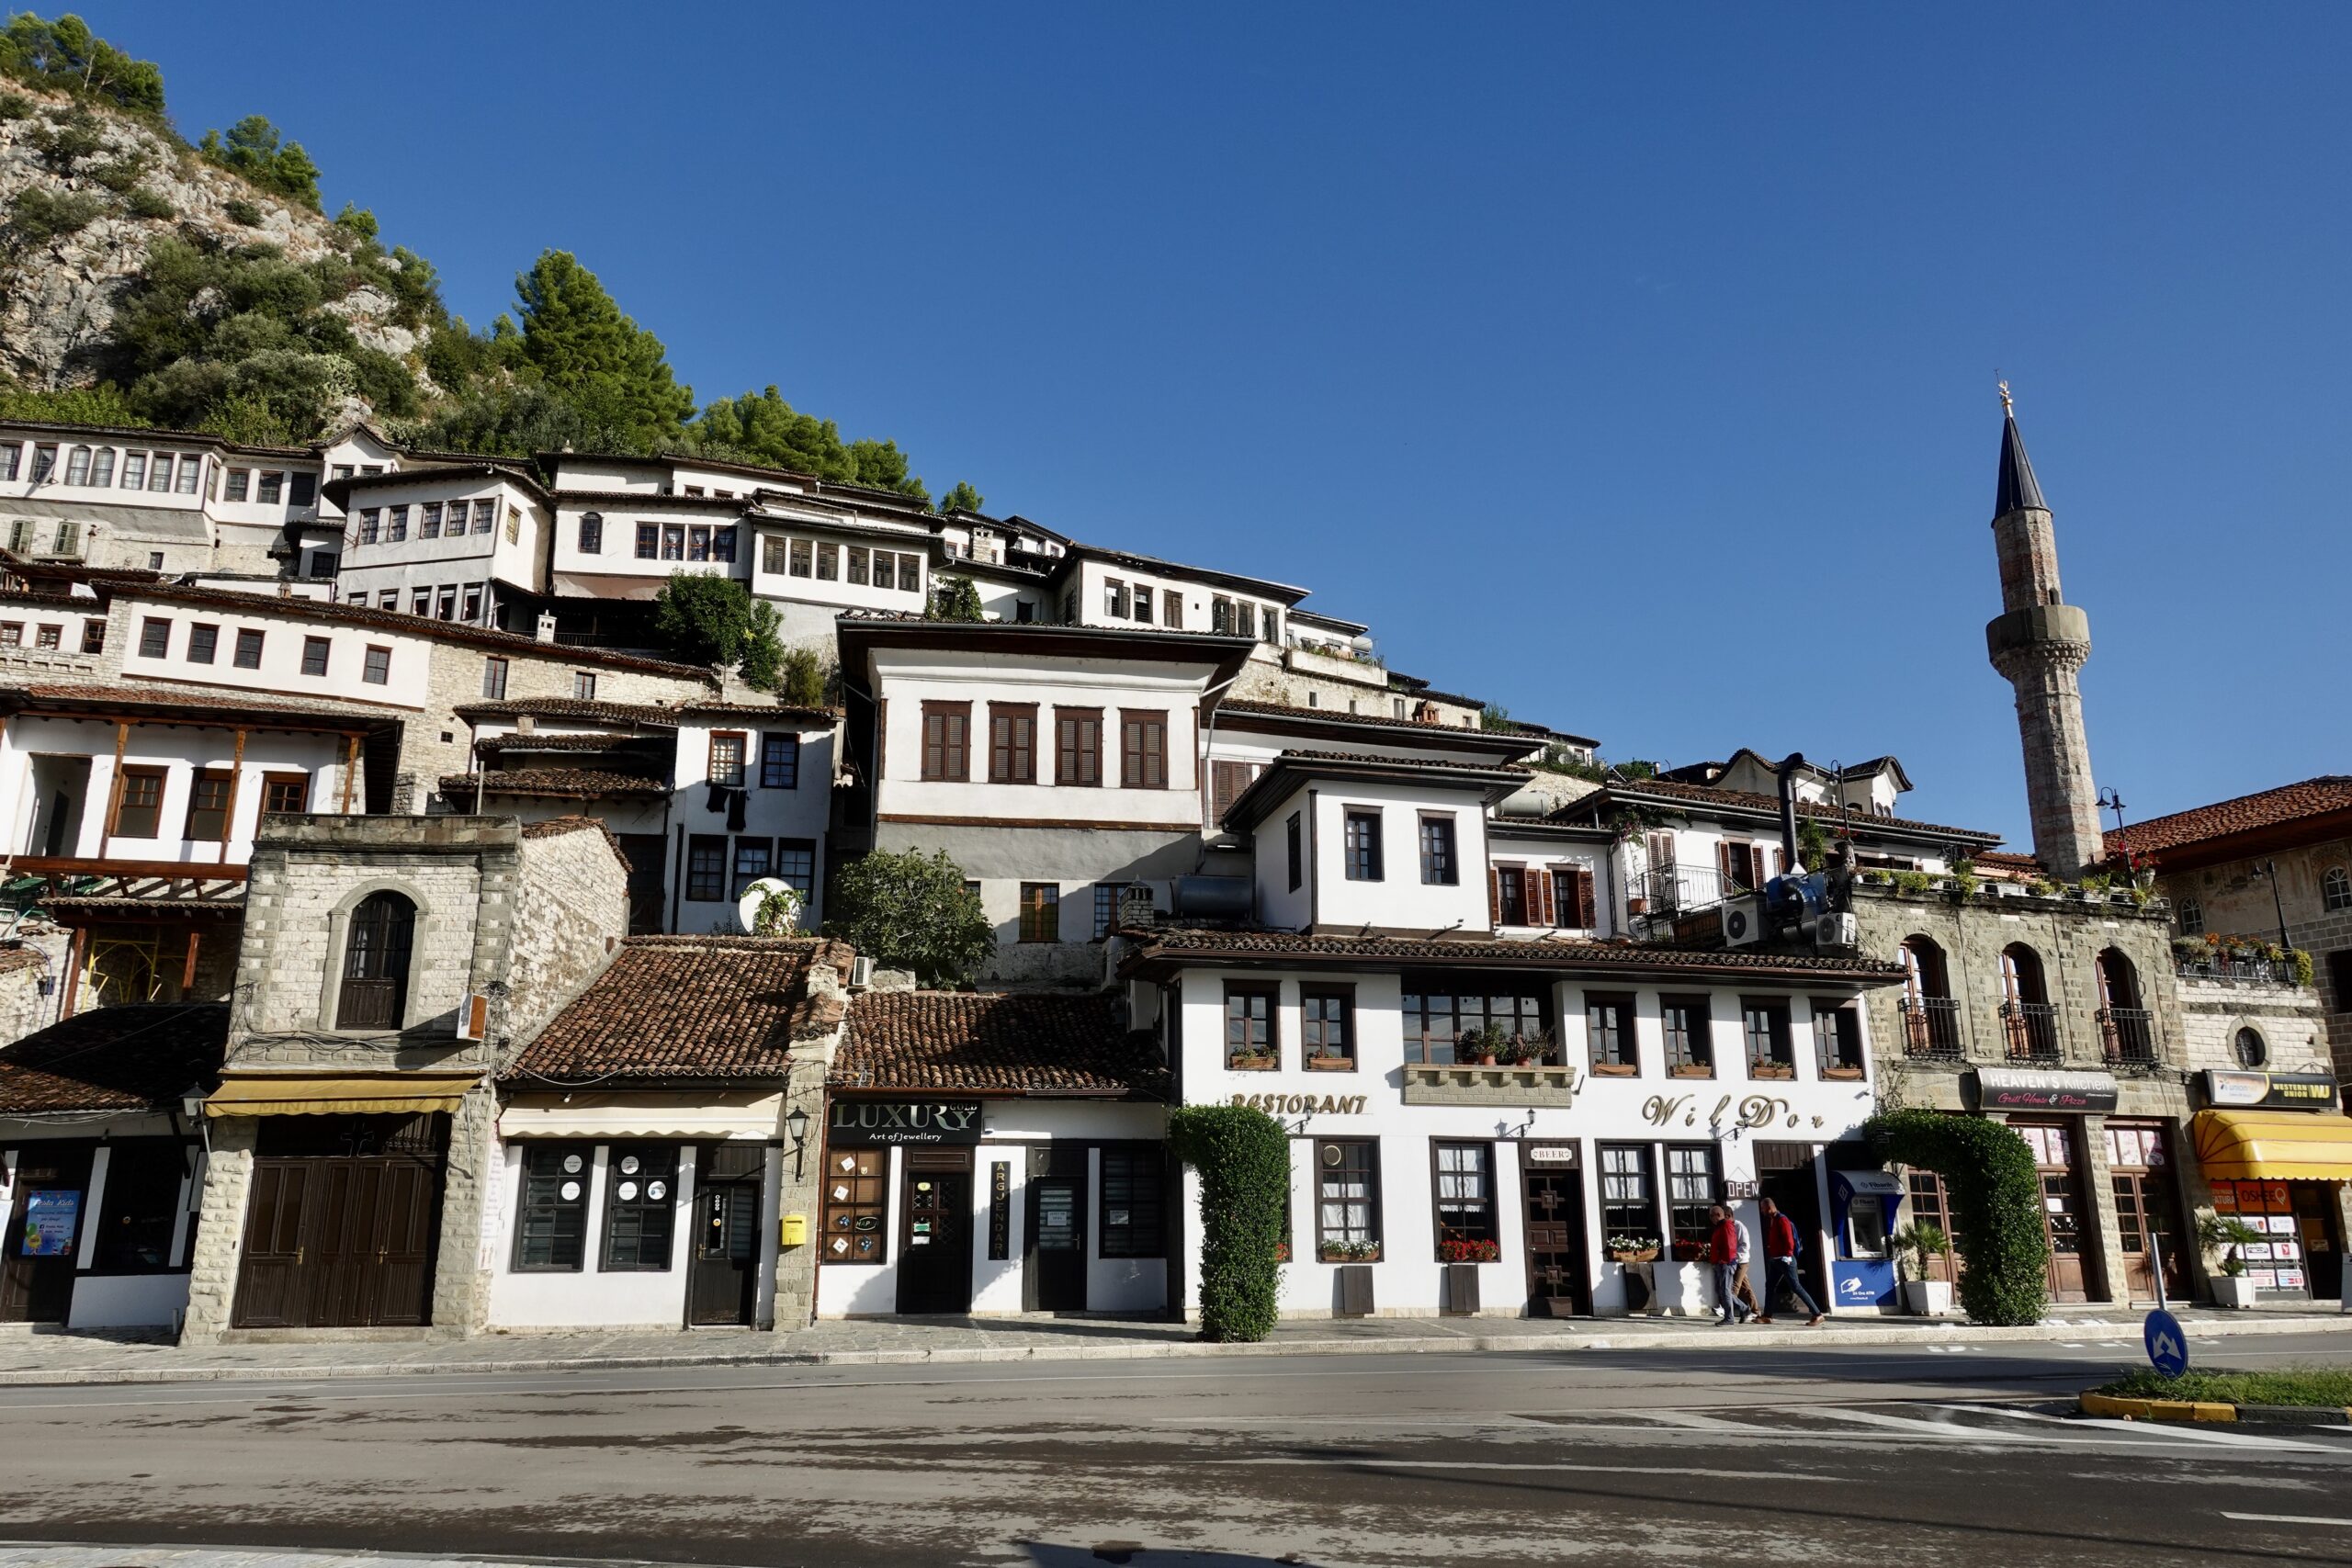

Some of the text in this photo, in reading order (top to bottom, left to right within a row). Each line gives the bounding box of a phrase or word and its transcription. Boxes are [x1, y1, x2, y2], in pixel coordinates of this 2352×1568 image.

[1990, 1074, 2109, 1090] HEAVEN'S Kitchen
[1997, 1093, 2021, 1103] Grill
[2022, 1093, 2048, 1104] House
[2049, 1094, 2057, 1105] &
[2310, 1085, 2330, 1099] WU
[257, 1101, 309, 1112] MINI
[949, 1102, 978, 1111] GOLD
[1231, 1093, 1368, 1114] RESTORANT
[833, 1103, 975, 1131] LUXURY
[888, 1132, 899, 1142] of
[899, 1132, 942, 1142] Jewellery
[1539, 1150, 1565, 1158] BEER
[1728, 1182, 1759, 1197] OPEN
[995, 1162, 1005, 1259] ARGJENDARI
